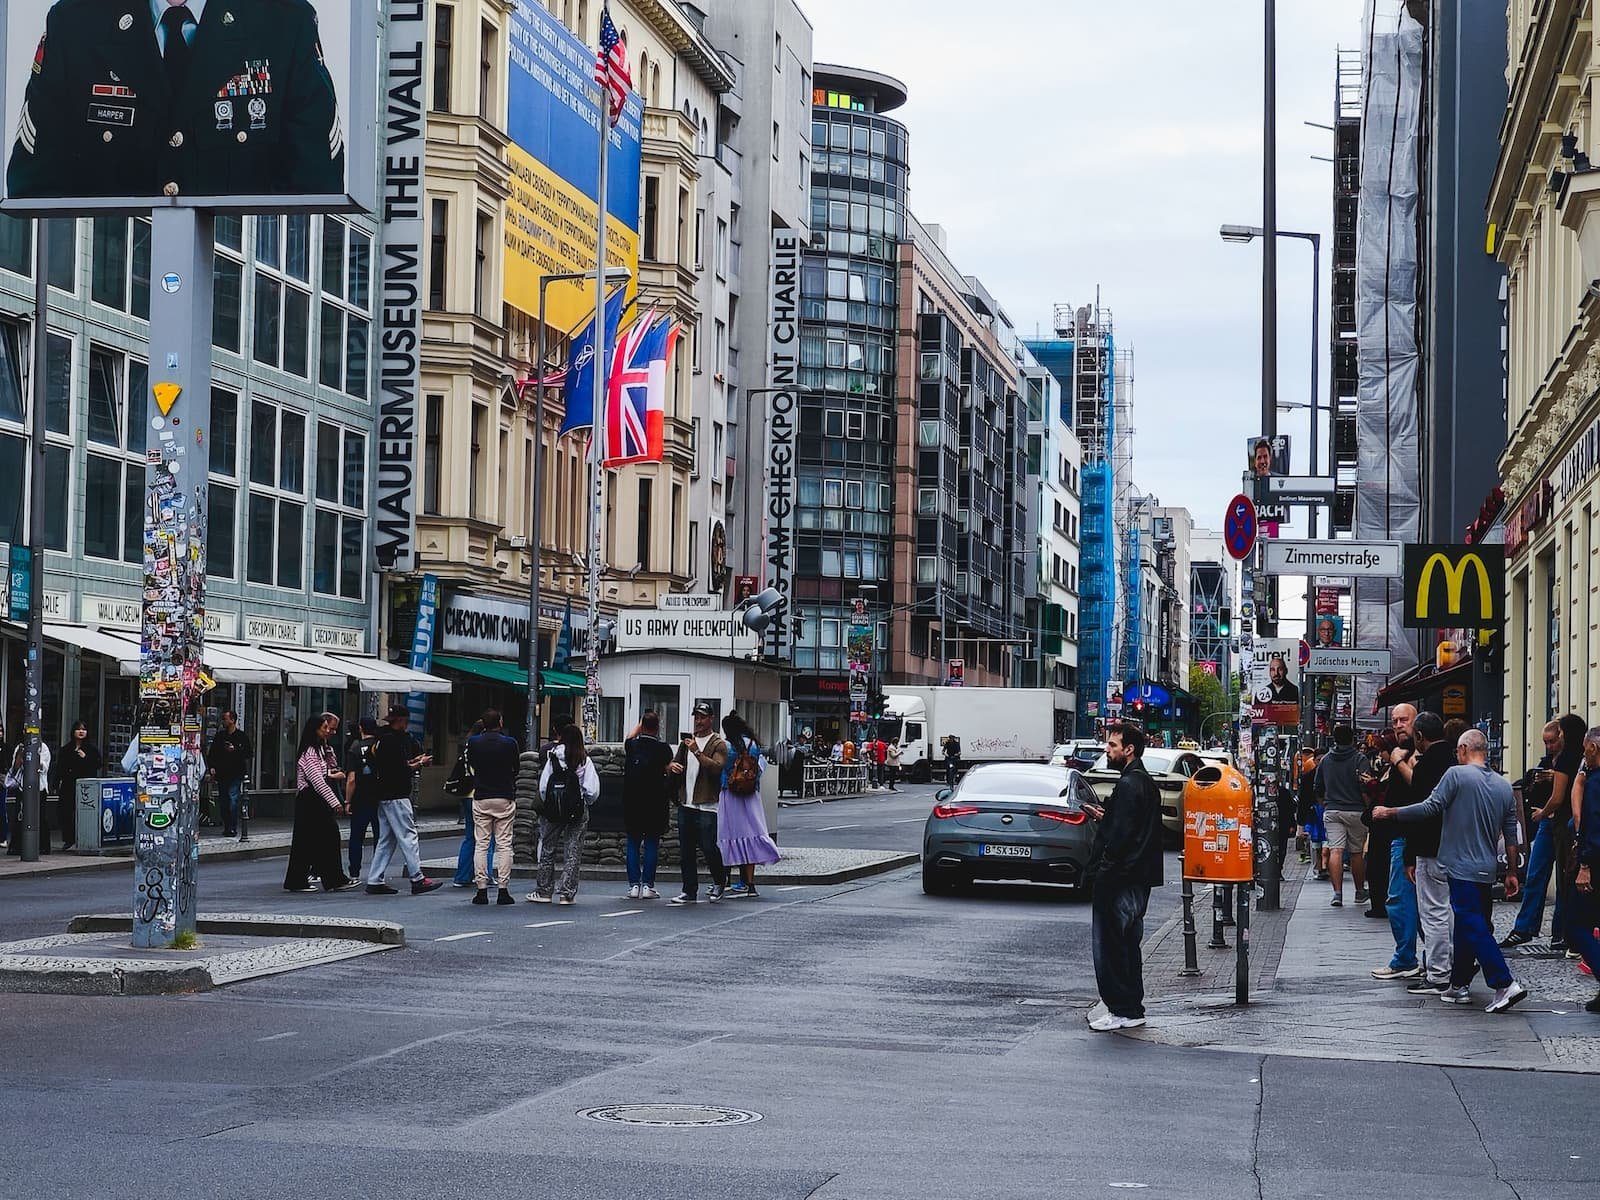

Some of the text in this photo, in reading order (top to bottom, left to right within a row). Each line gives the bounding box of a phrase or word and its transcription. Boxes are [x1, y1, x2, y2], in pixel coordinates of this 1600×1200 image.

[387, 41, 423, 146] WALL
[97, 109, 124, 120] HARPER
[385, 156, 420, 224] THE
[773, 237, 796, 344] CHARLIE
[377, 244, 418, 557] MAUERMUSEUM
[769, 352, 794, 519] CHECKPONT
[1255, 505, 1284, 517] RACH
[769, 527, 790, 571] AM
[1285, 548, 1380, 568] Zimmerstraße
[98, 603, 140, 623] WALL MUSEUM
[249, 621, 297, 641] CHECKPOINT CHARLIE
[445, 608, 500, 640] CHECKPOINT
[626, 619, 642, 636] US
[647, 619, 679, 636] ARMY
[314, 629, 357, 648] CHECKPOINT CHARLIE
[1314, 657, 1380, 667] Jüdisches Museum
[1141, 685, 1152, 697] U
[985, 845, 1030, 856] B SX 1596
